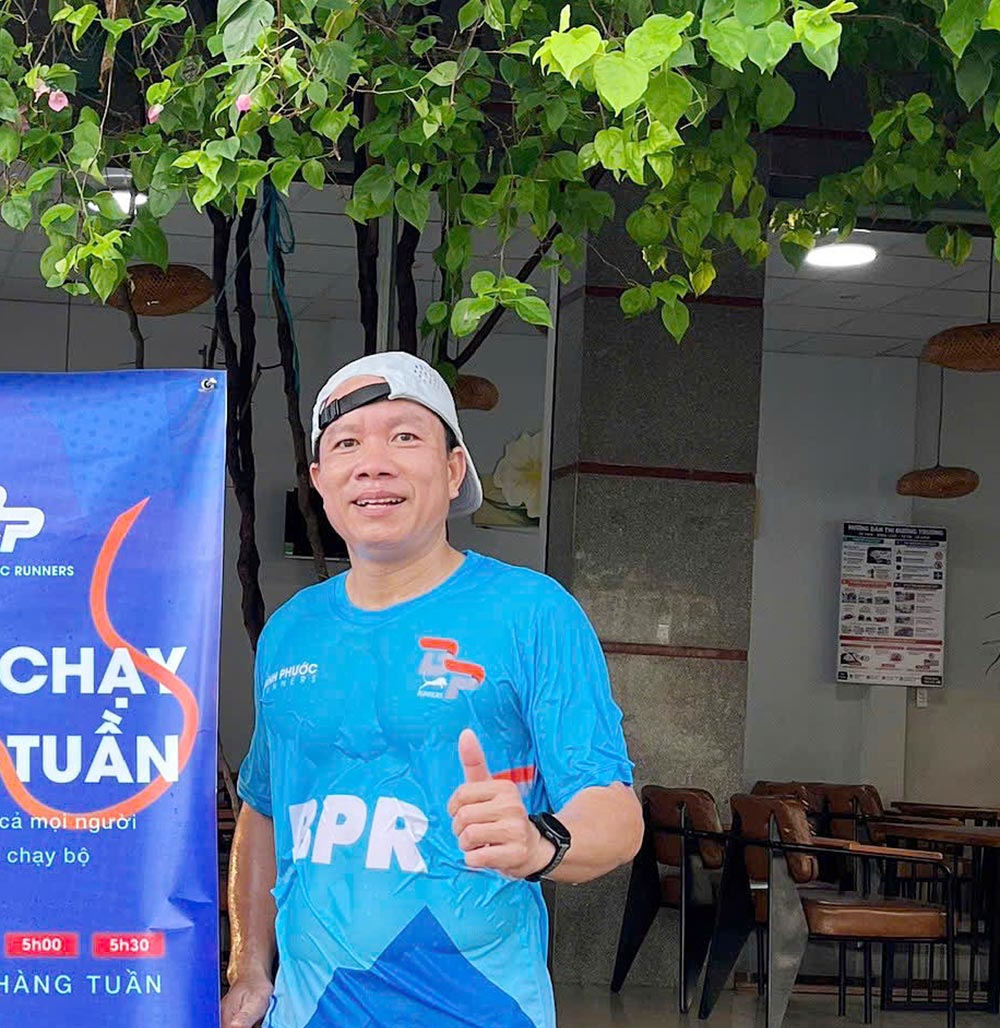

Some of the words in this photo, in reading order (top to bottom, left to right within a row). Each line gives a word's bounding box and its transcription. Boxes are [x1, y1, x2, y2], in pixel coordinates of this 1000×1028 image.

[14, 564, 75, 577] RUNNERS
[7, 709, 180, 784] TUẦN
[30, 813, 67, 833] mọi
[75, 812, 137, 835] người
[289, 794, 429, 874] BPR
[6, 846, 56, 868] chạy
[64, 846, 91, 867] bộ
[21, 936, 62, 952] 5h00
[109, 937, 150, 953] 5h30
[87, 968, 163, 995] TUẦN
